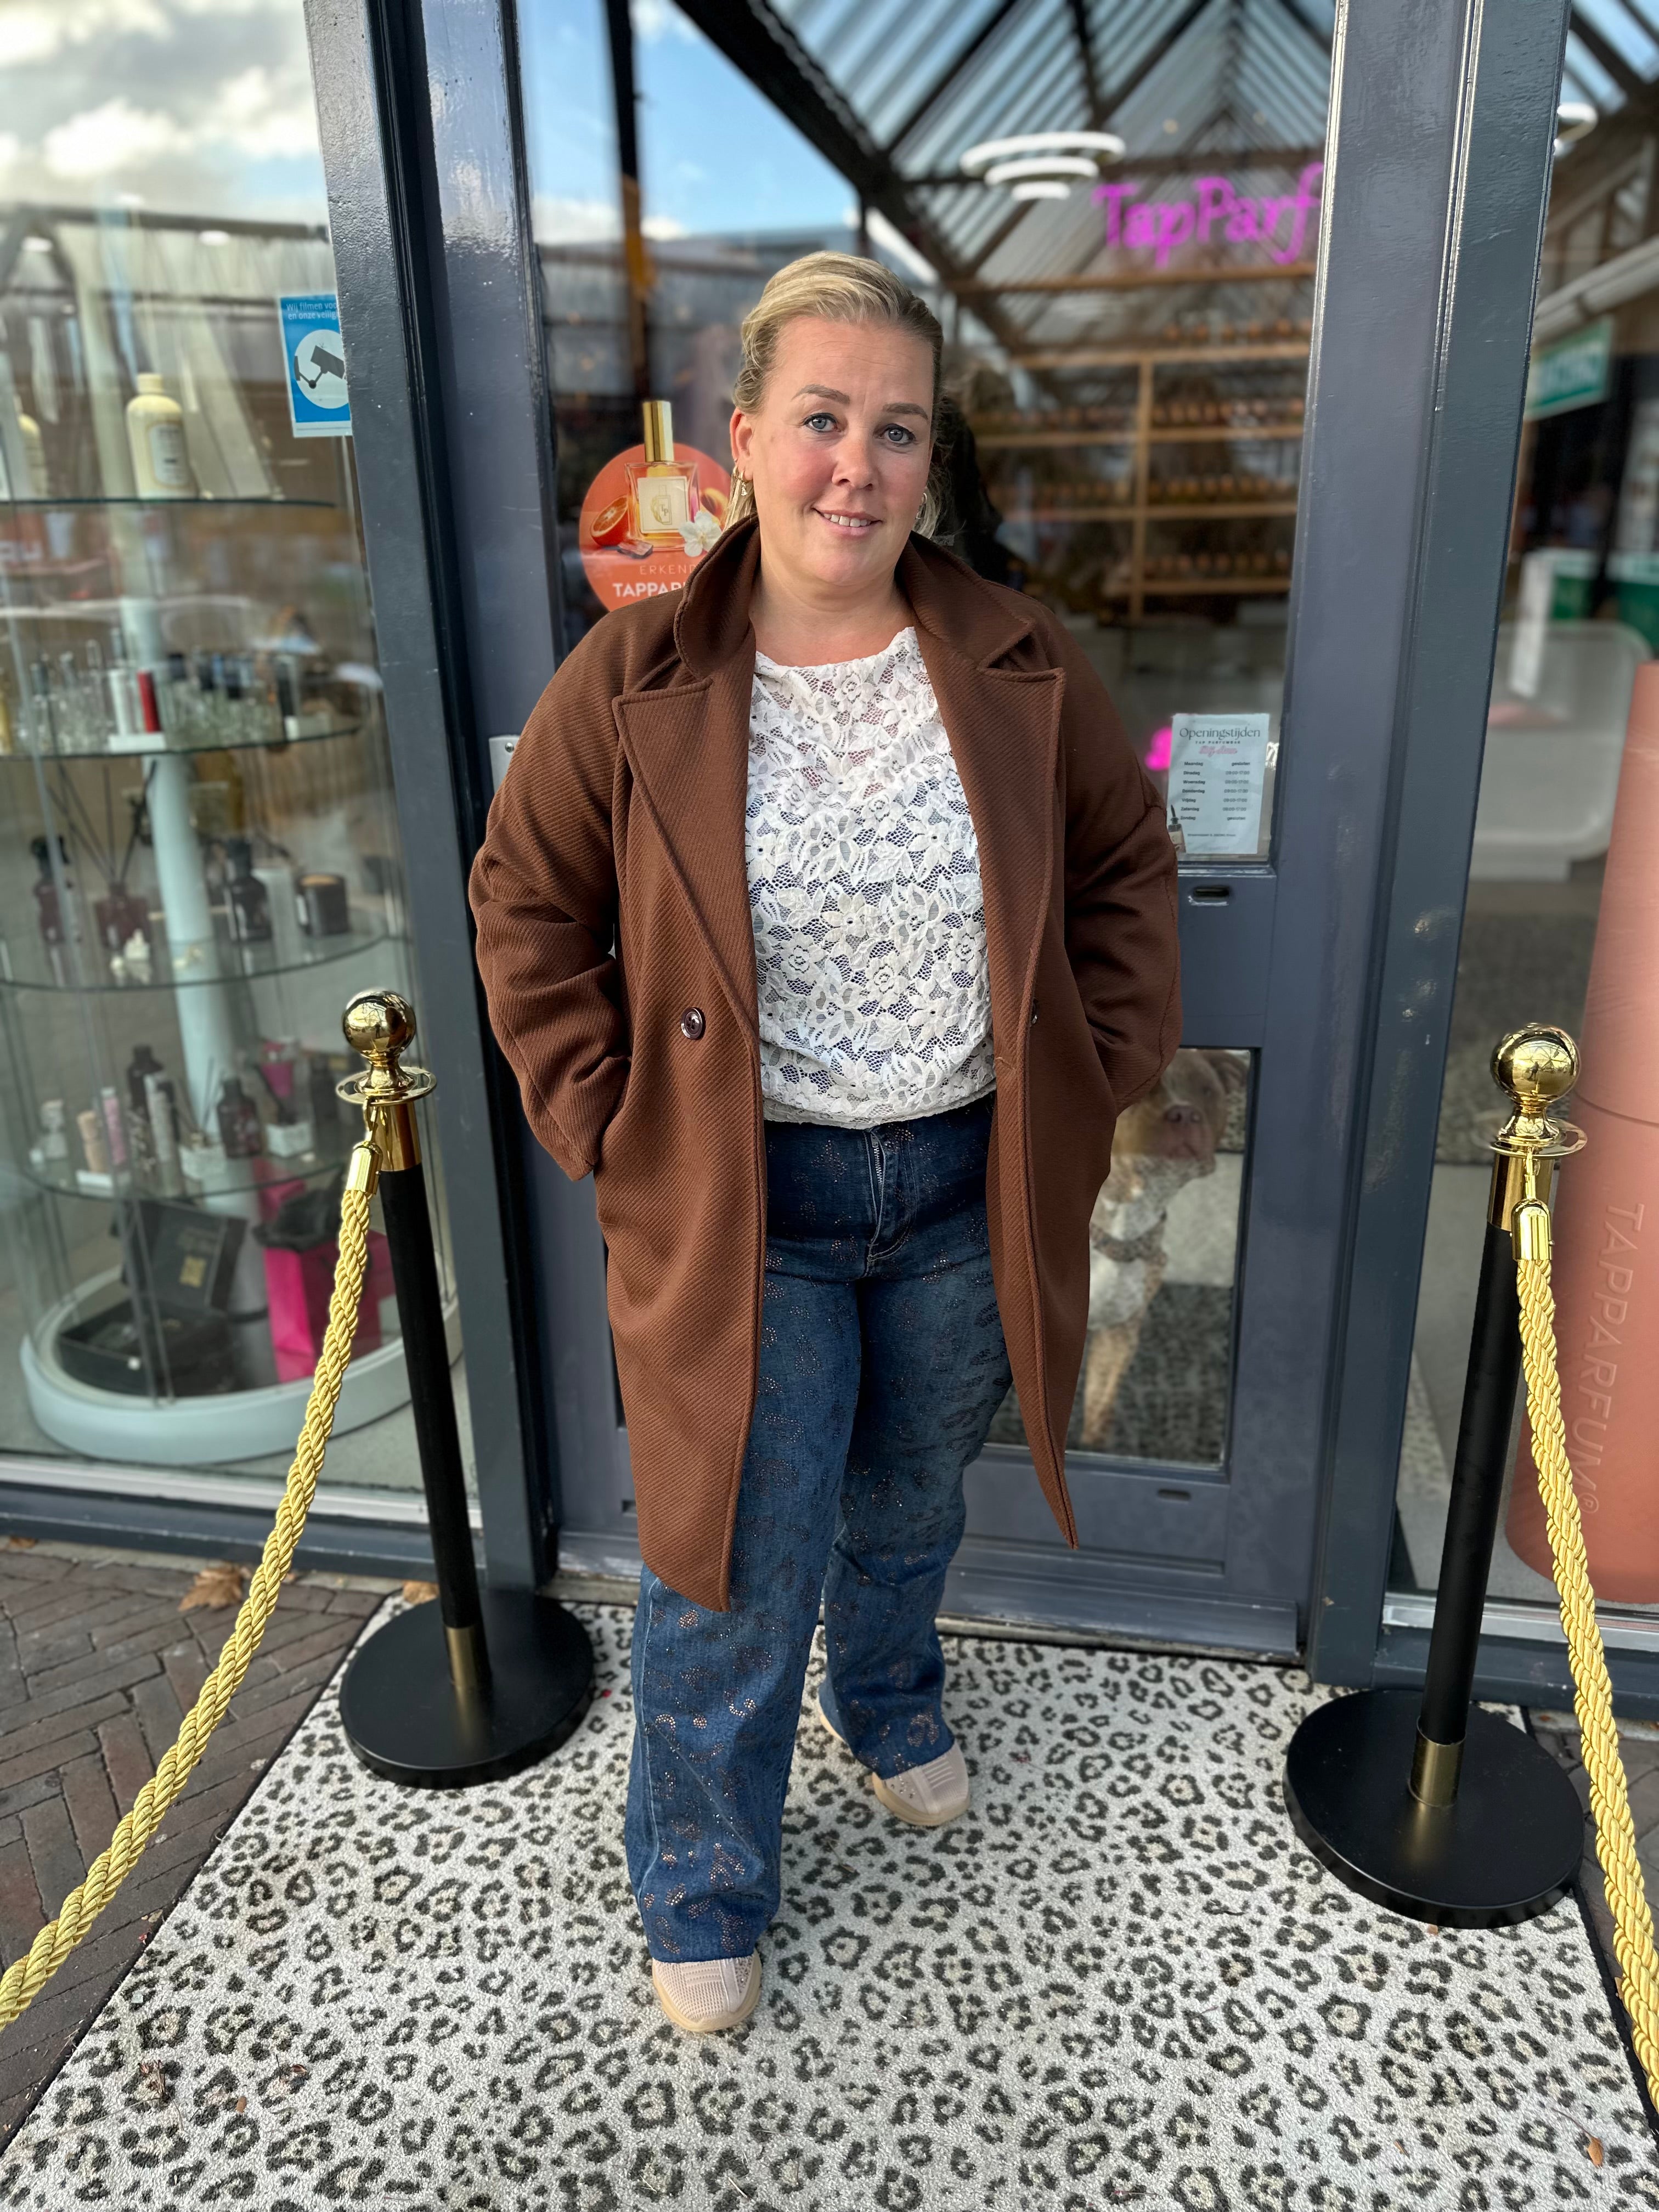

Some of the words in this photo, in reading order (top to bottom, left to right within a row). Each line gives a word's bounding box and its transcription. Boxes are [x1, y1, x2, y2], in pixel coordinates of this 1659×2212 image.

[286, 303, 298, 313] Wij
[299, 302, 323, 311] filmen
[1180, 727, 1260, 740] Openingstijden
